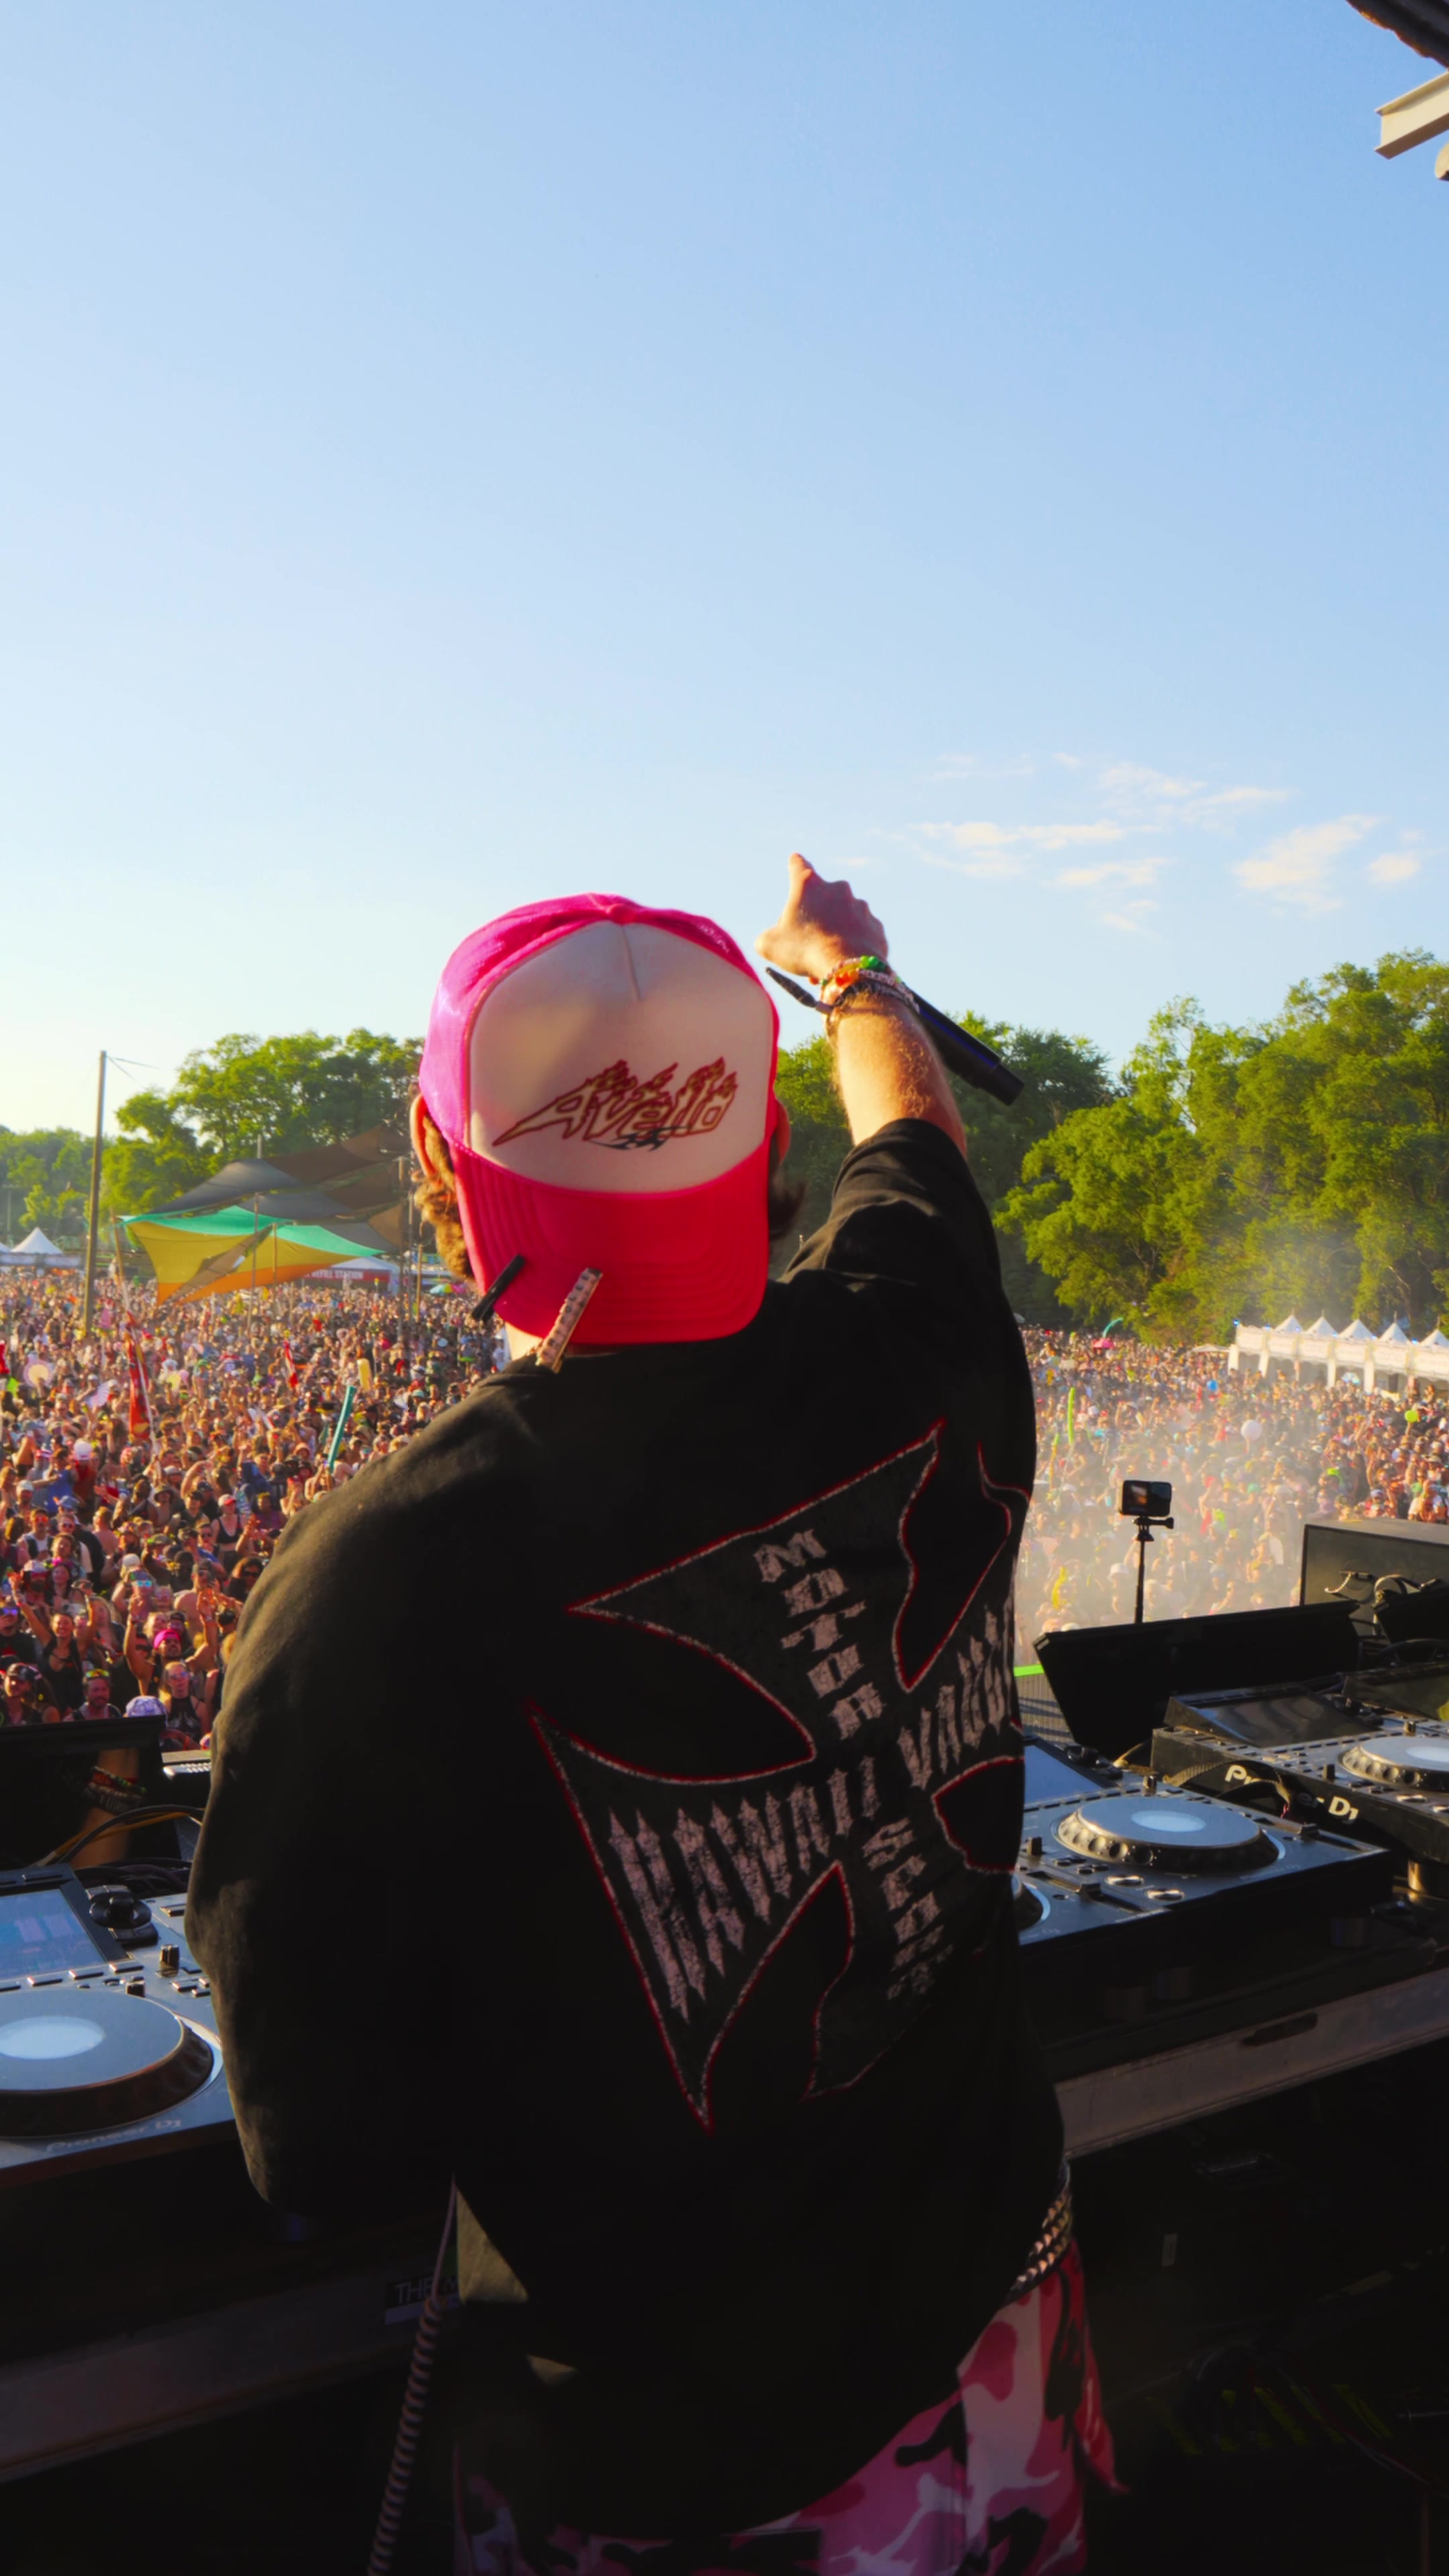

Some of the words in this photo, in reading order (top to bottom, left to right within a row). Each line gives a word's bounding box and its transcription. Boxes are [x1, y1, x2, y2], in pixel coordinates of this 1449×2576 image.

[753, 1528, 887, 1741] MOTOR
[1328, 1796, 1359, 1824] DJ
[46, 2125, 148, 2153] Pioneer
[155, 2119, 182, 2129] DJ
